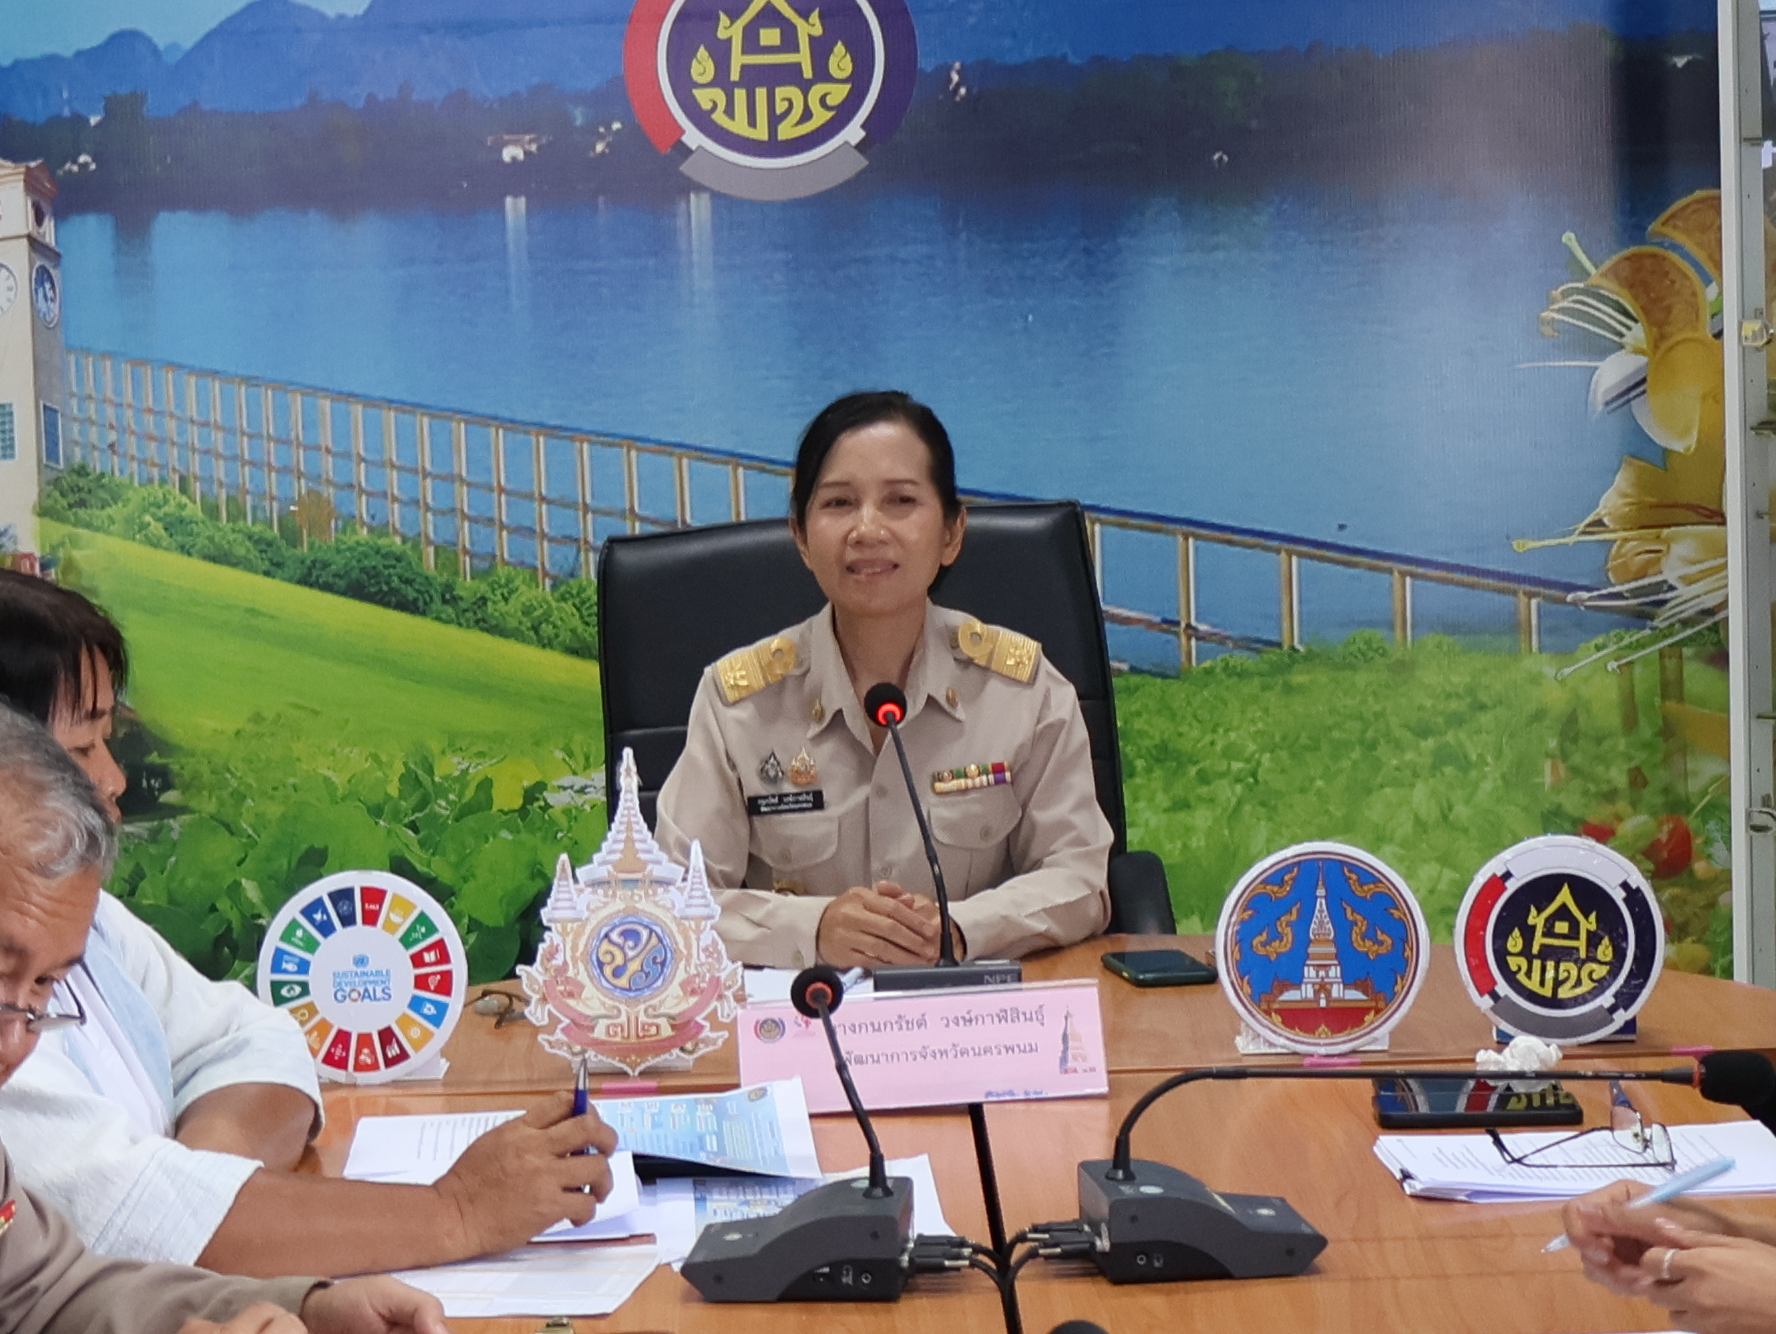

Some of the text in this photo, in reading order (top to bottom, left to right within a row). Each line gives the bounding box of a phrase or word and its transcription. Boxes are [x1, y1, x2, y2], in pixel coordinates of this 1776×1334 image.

[332, 969, 392, 979] SUSTAINABLE
[332, 979, 392, 988] DEVELOPMENT
[333, 988, 393, 1003] GOALS
[831, 1008, 928, 1040] างกนกรัชต์
